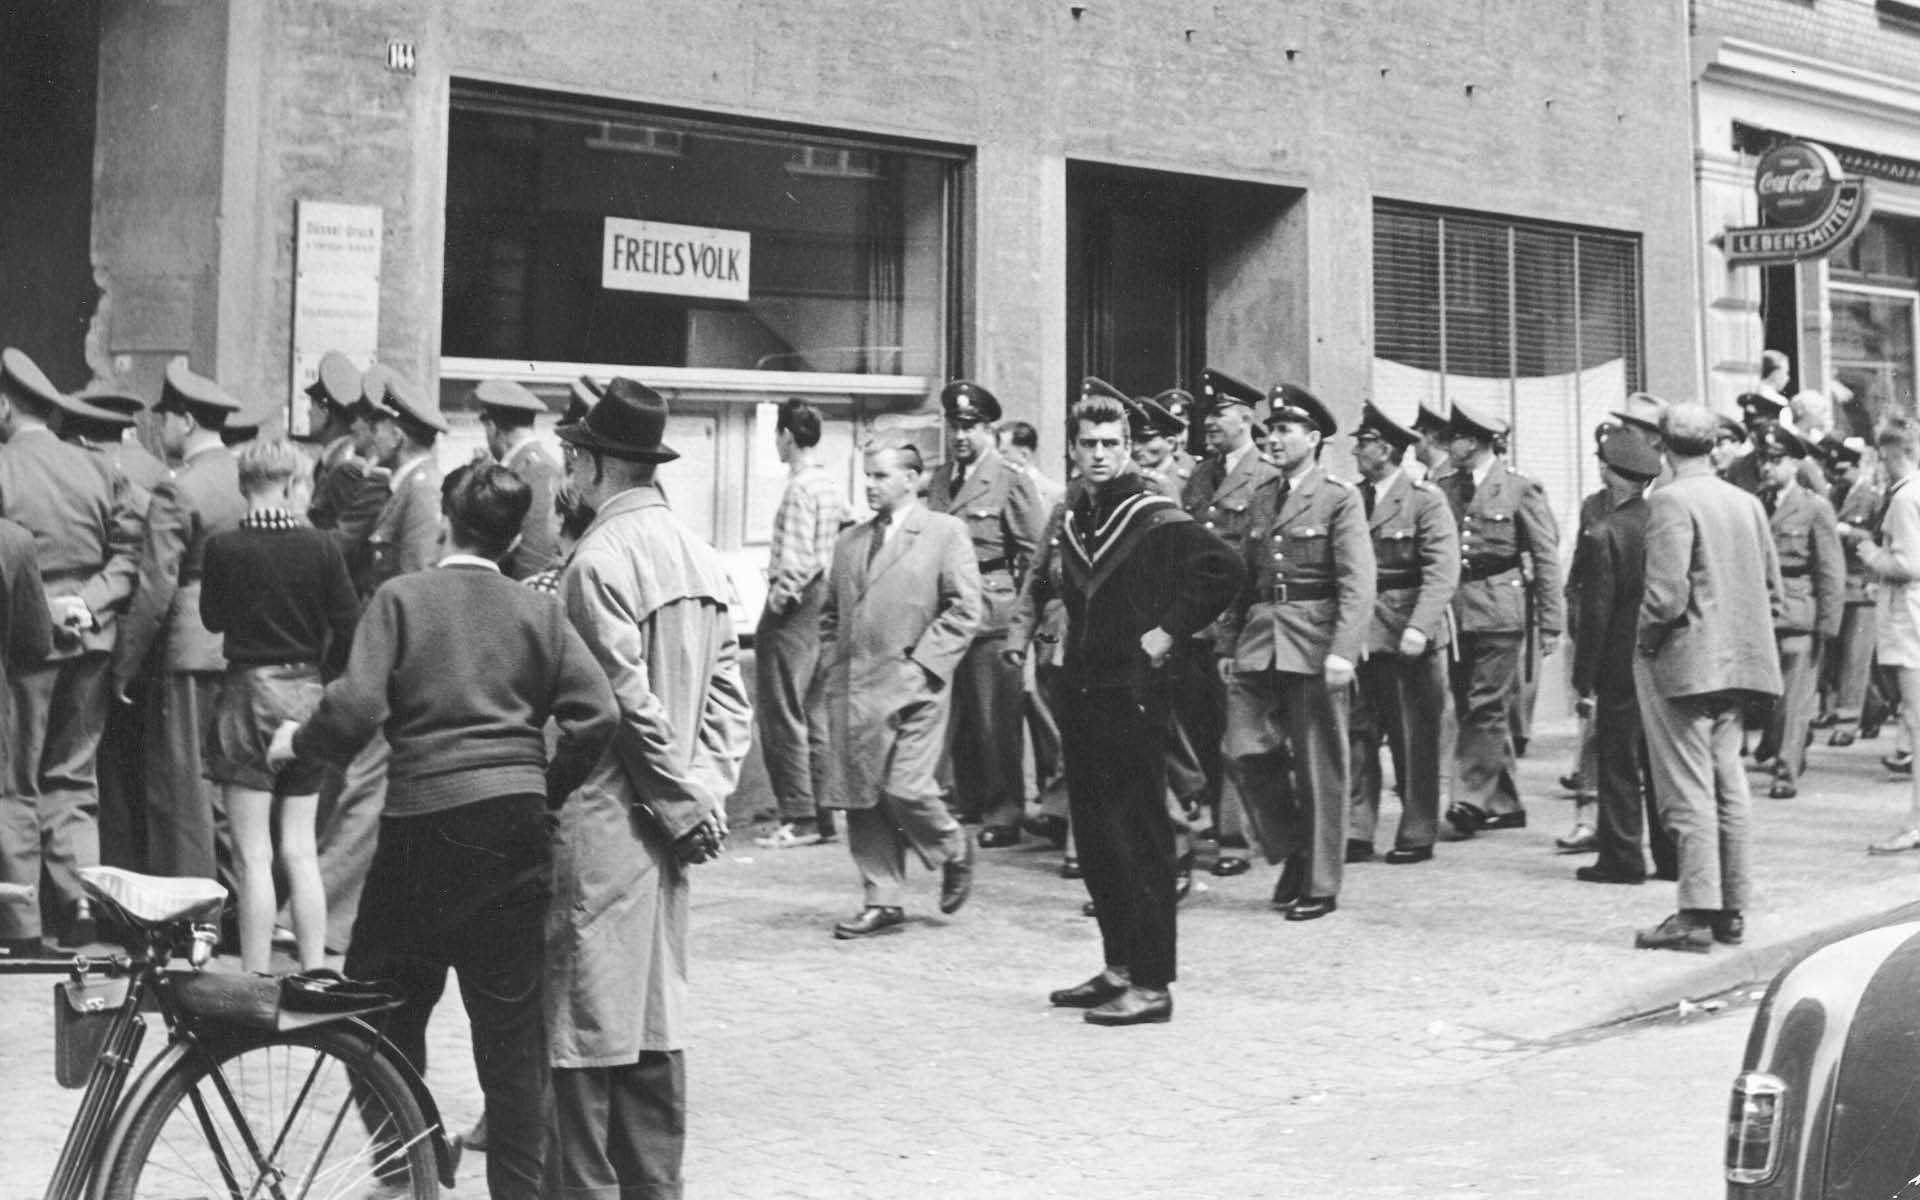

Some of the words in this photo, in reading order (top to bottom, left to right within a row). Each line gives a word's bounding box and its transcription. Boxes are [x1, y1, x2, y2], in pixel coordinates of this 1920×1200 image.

[1739, 198, 1854, 252] LEBENSMITTEL
[613, 234, 685, 276] FREIES
[687, 242, 741, 281] VOLK
